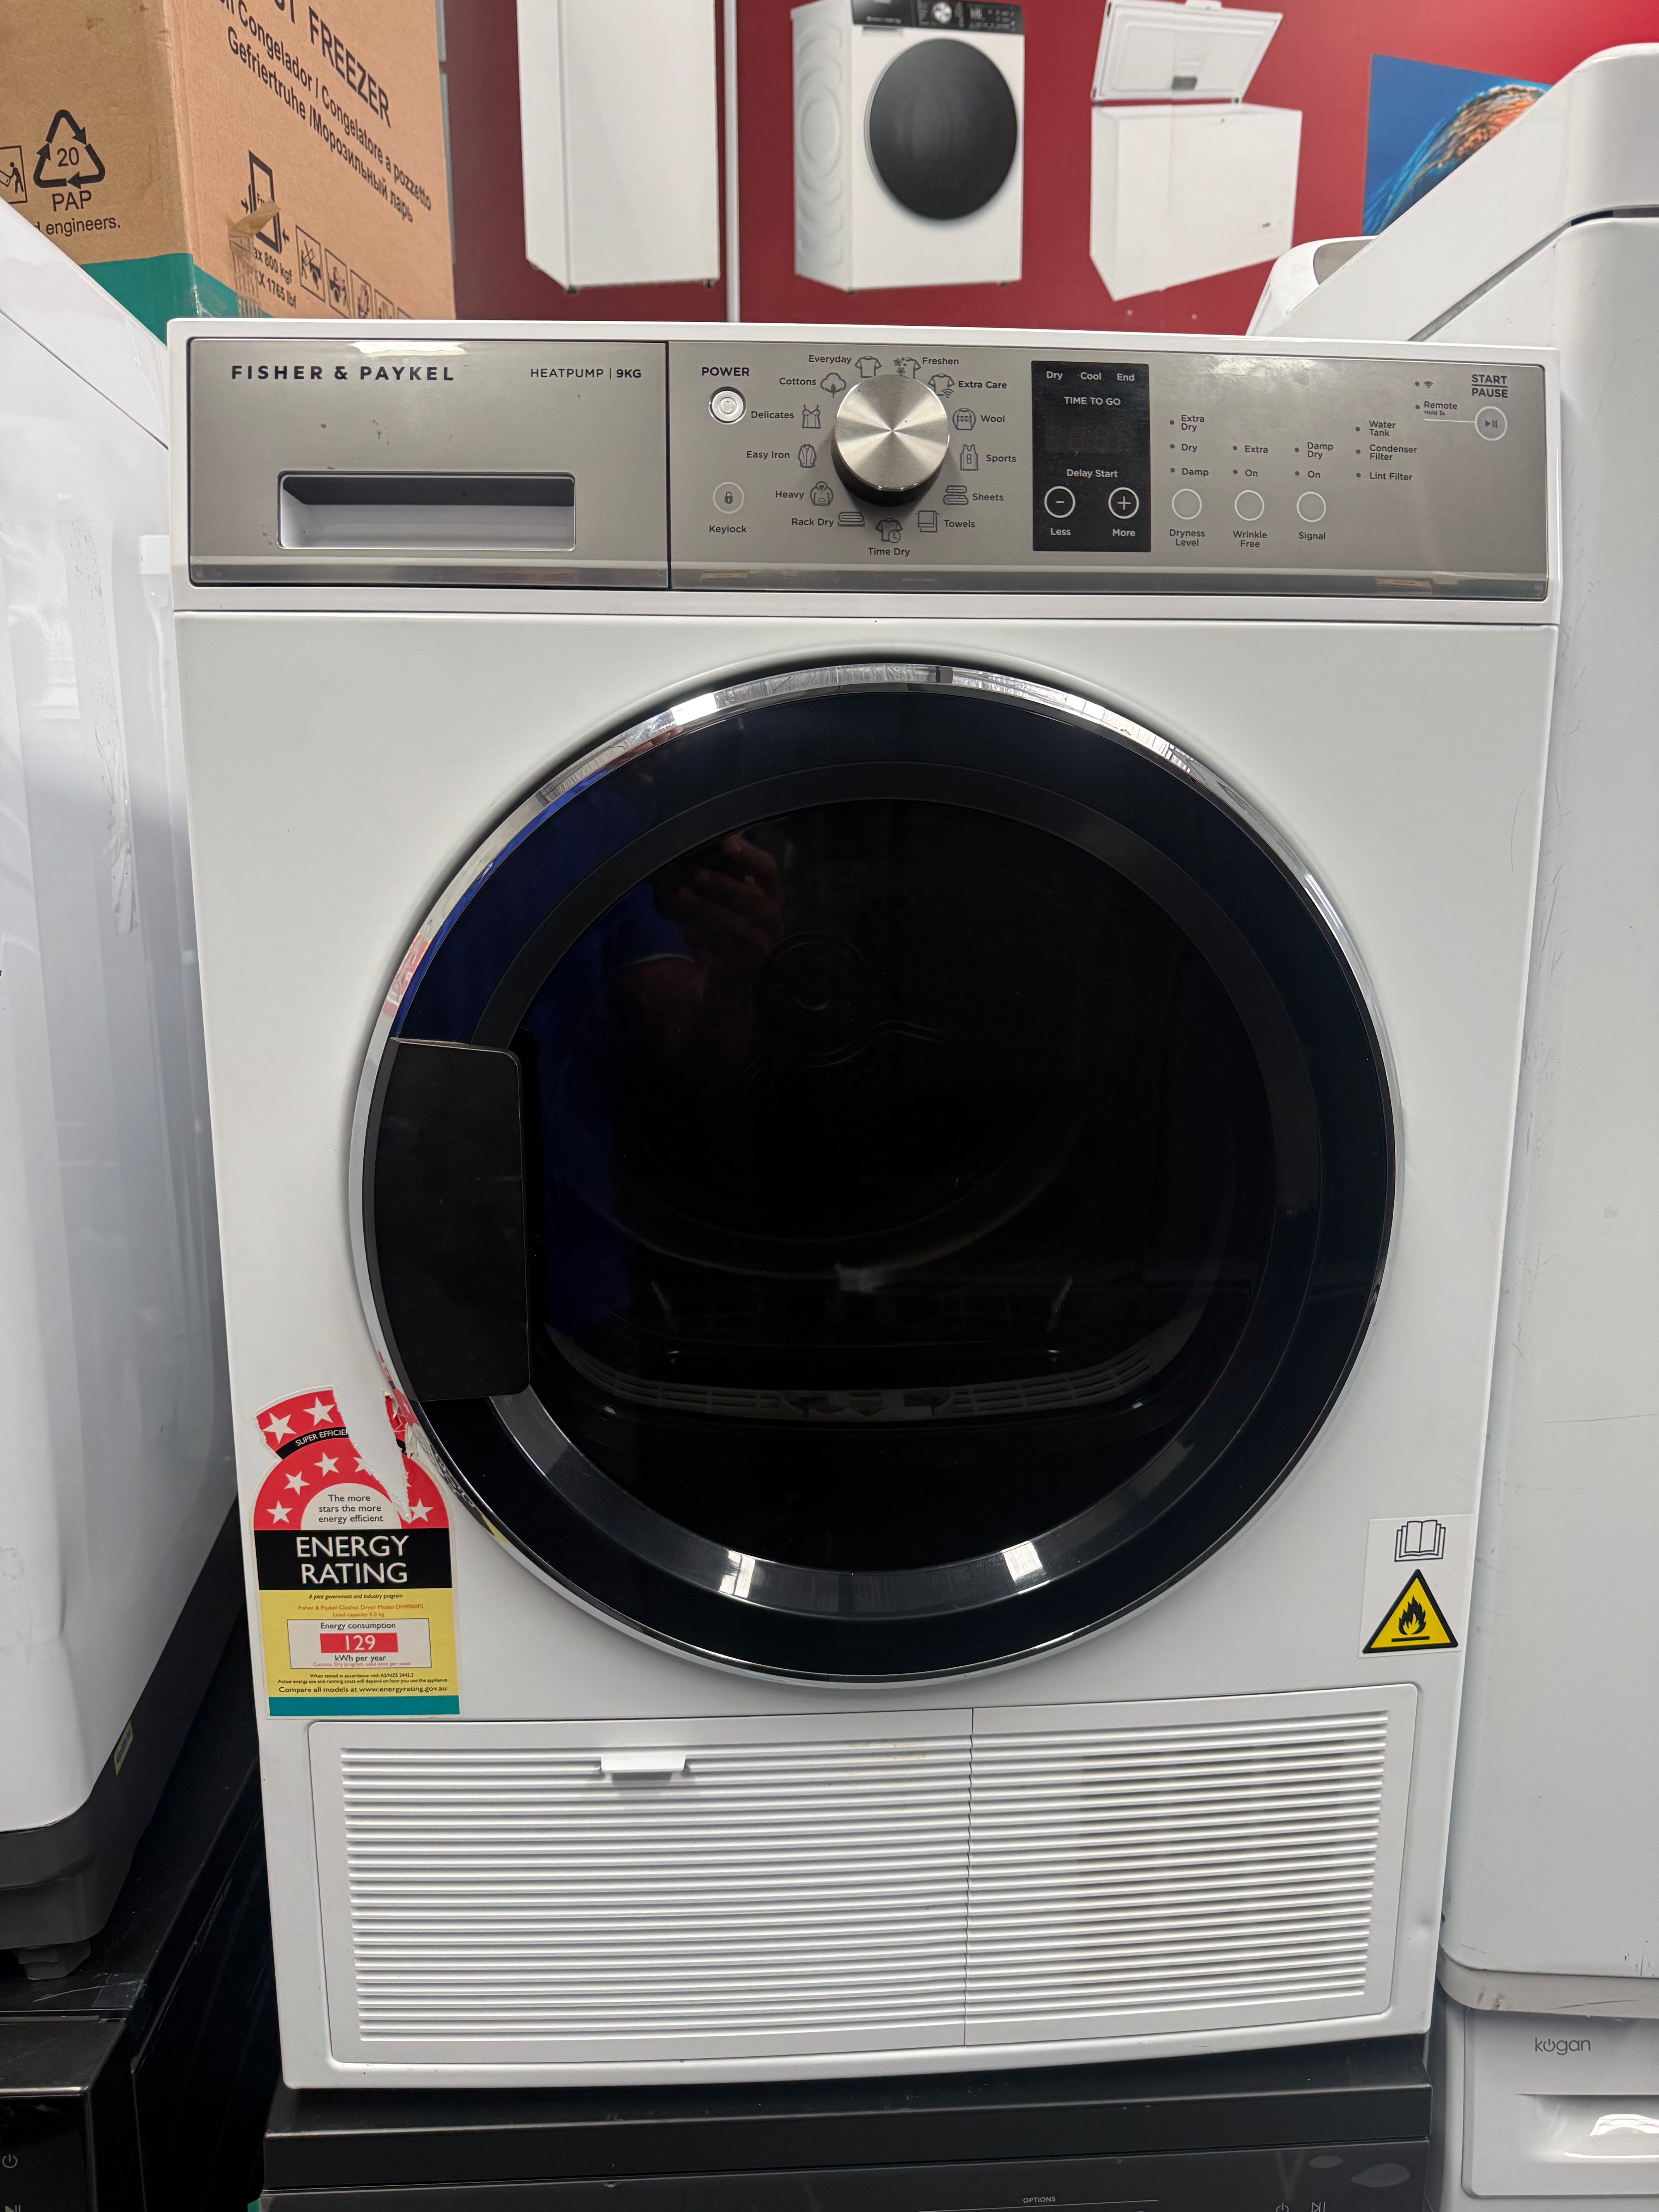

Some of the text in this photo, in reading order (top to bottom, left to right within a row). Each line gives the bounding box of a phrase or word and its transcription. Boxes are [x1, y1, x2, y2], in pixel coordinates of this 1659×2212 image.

[309, 5, 391, 129] FREEZER
[228, 26, 306, 120] Gefriertruhe
[239, 0, 312, 91] Congelador
[322, 85, 383, 165] Congelatore
[385, 156, 392, 173] a
[393, 162, 431, 211] pozzetto
[57, 147, 79, 167] 20
[52, 190, 92, 212] PAP
[46, 217, 120, 237] engineers.
[265, 252, 278, 273] 800
[267, 278, 285, 301] 1765
[809, 355, 852, 364] Everyday
[232, 366, 453, 381] FISHER & PAYKEL
[531, 369, 603, 378] HEATPUMP
[617, 369, 641, 378] 9KG
[702, 367, 750, 376] POWER
[1046, 371, 1063, 380] Dry
[1472, 374, 1507, 384] START
[1472, 388, 1508, 398] PAUSE
[1424, 401, 1457, 409] Remote
[1181, 424, 1197, 432] Dry
[1182, 443, 1197, 452] Dry
[1307, 442, 1333, 450] Damp
[1370, 444, 1417, 453] Condenser
[747, 451, 768, 459] Easy
[986, 455, 1016, 463] Sports
[1067, 469, 1118, 478] Delay Start
[1182, 468, 1209, 476] Damp
[776, 491, 804, 499] Heavy
[818, 519, 834, 527] Dry
[709, 525, 747, 534] Keylock
[1169, 529, 1205, 538] Dryness
[1233, 531, 1267, 539] Wrinkle
[1298, 532, 1326, 540] Signal
[894, 548, 910, 557] Dry
[295, 1433, 318, 1446] SUPER
[296, 1535, 409, 1558] ENERGY
[301, 1562, 407, 1584] RATING
[321, 1622, 396, 1630] Energy consumption
[345, 1635, 376, 1650] 129
[1535, 2037, 1590, 2055] kogan
